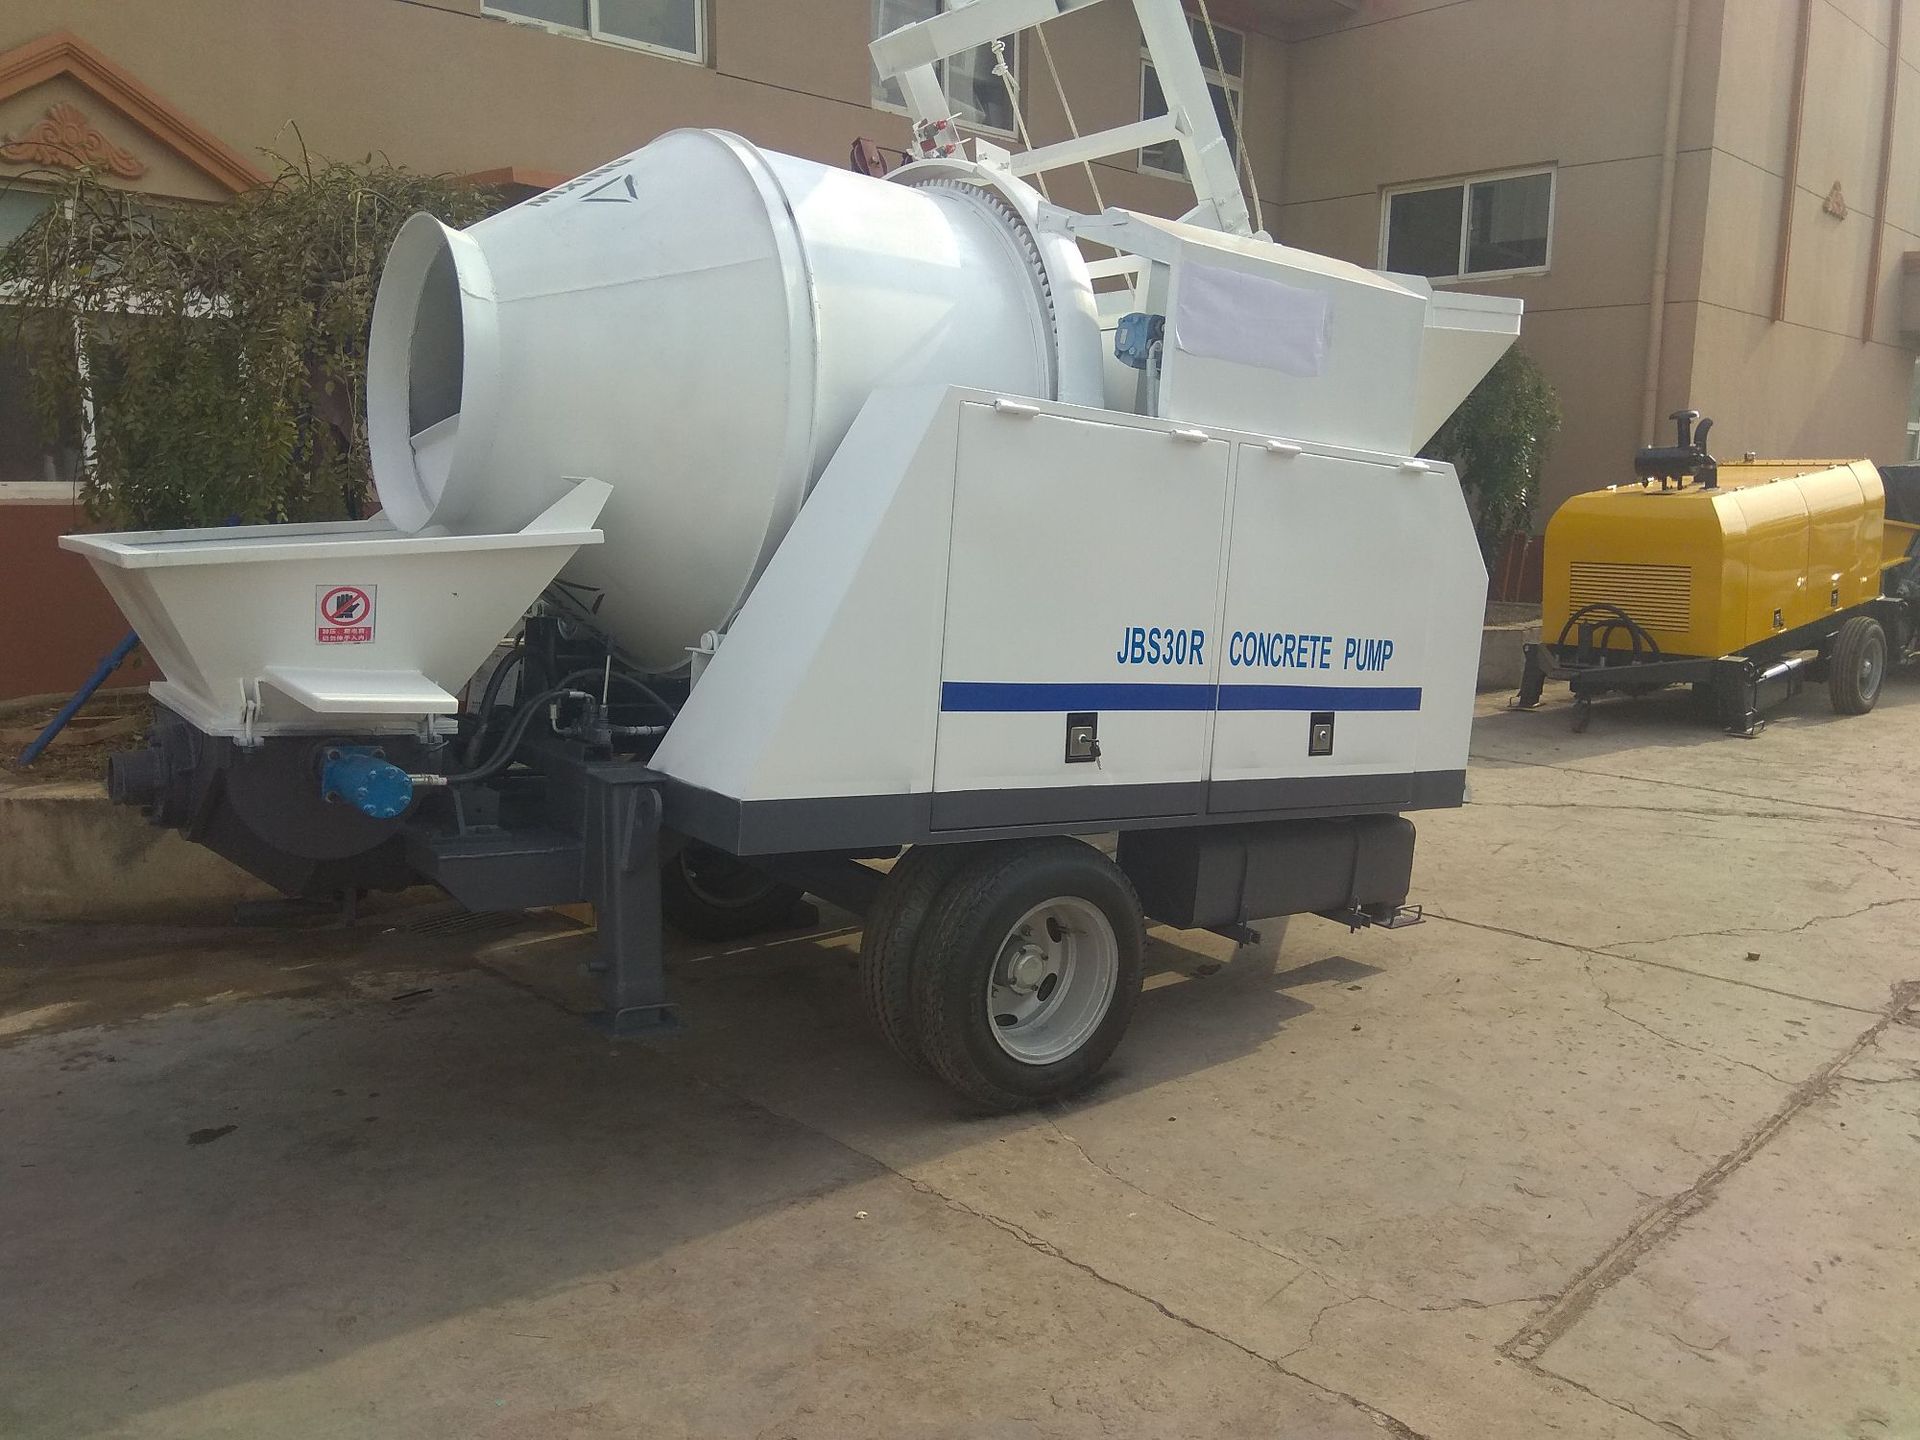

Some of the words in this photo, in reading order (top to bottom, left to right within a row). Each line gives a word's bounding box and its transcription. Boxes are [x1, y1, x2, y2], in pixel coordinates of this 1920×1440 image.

[1117, 627, 1204, 665] JBS30R
[1229, 631, 1333, 669] CONCRETE
[1343, 638, 1394, 671] PUMP
